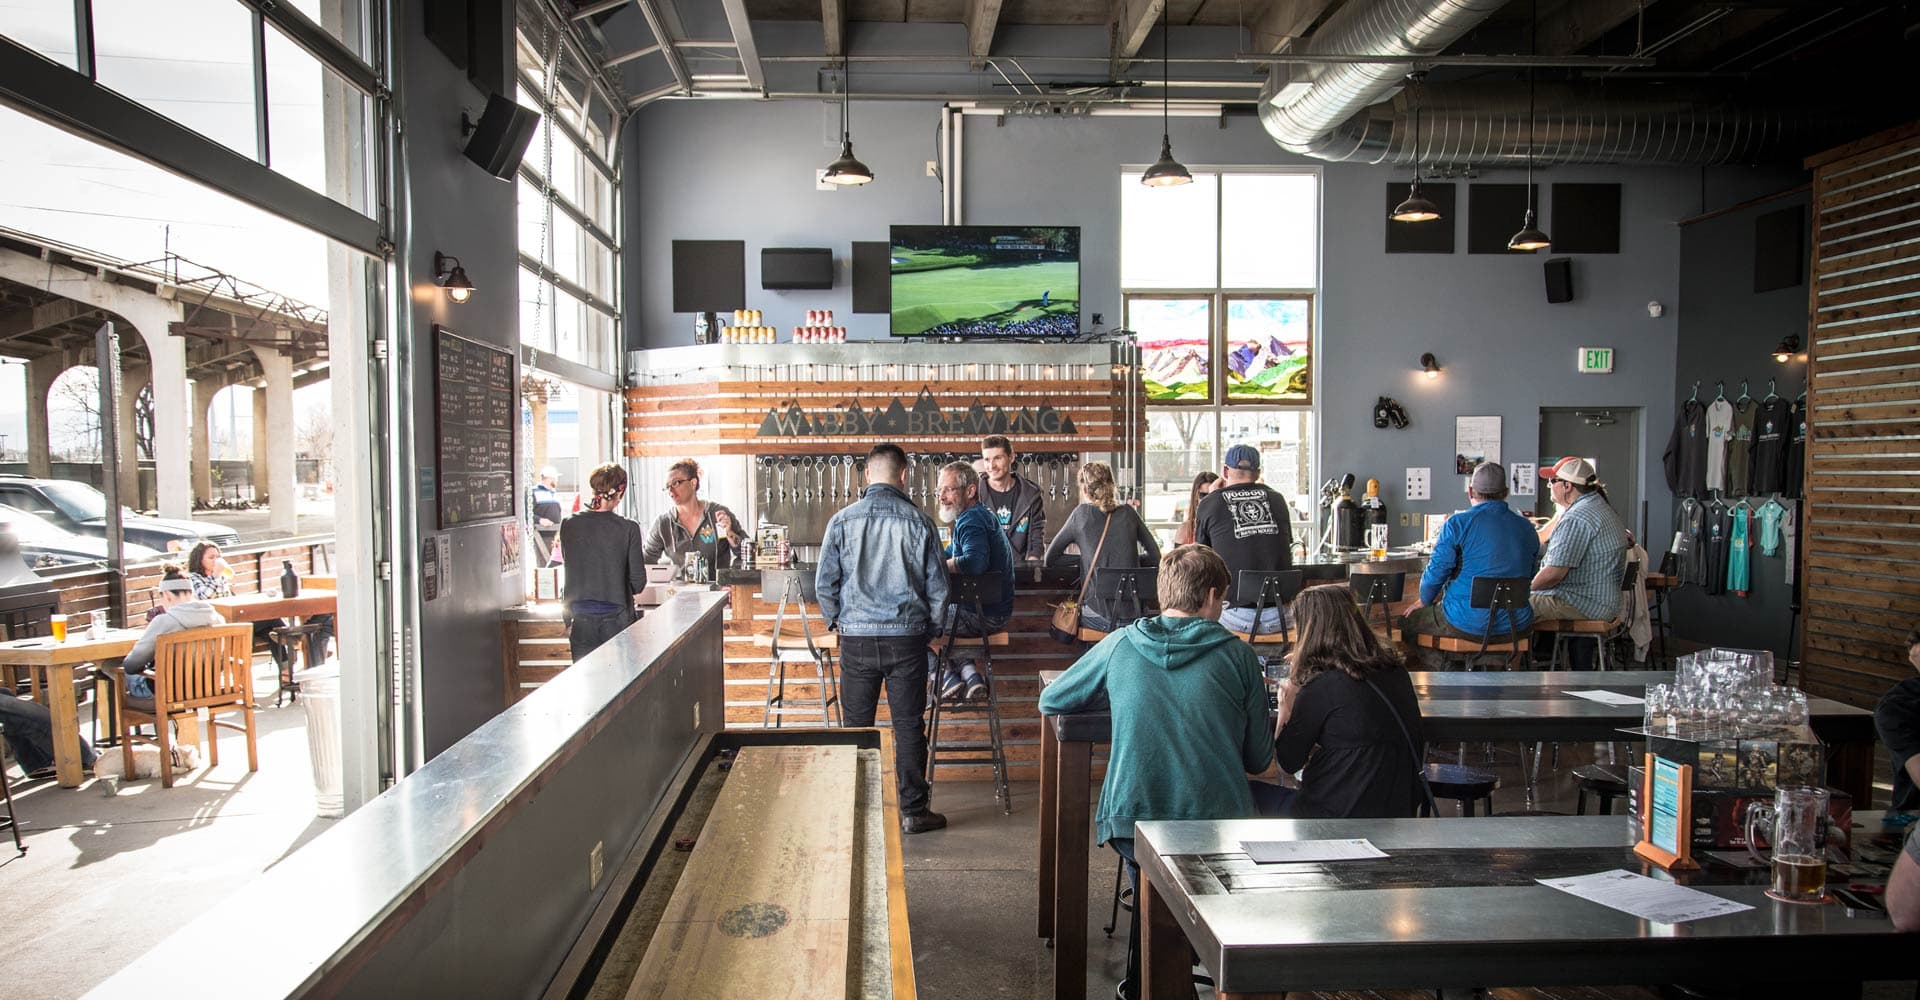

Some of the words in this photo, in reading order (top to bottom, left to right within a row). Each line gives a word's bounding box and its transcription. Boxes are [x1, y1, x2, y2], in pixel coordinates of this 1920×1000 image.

[1587, 350, 1611, 368] EXIT
[771, 411, 879, 435] WIBBY
[904, 410, 1063, 434] BREWING
